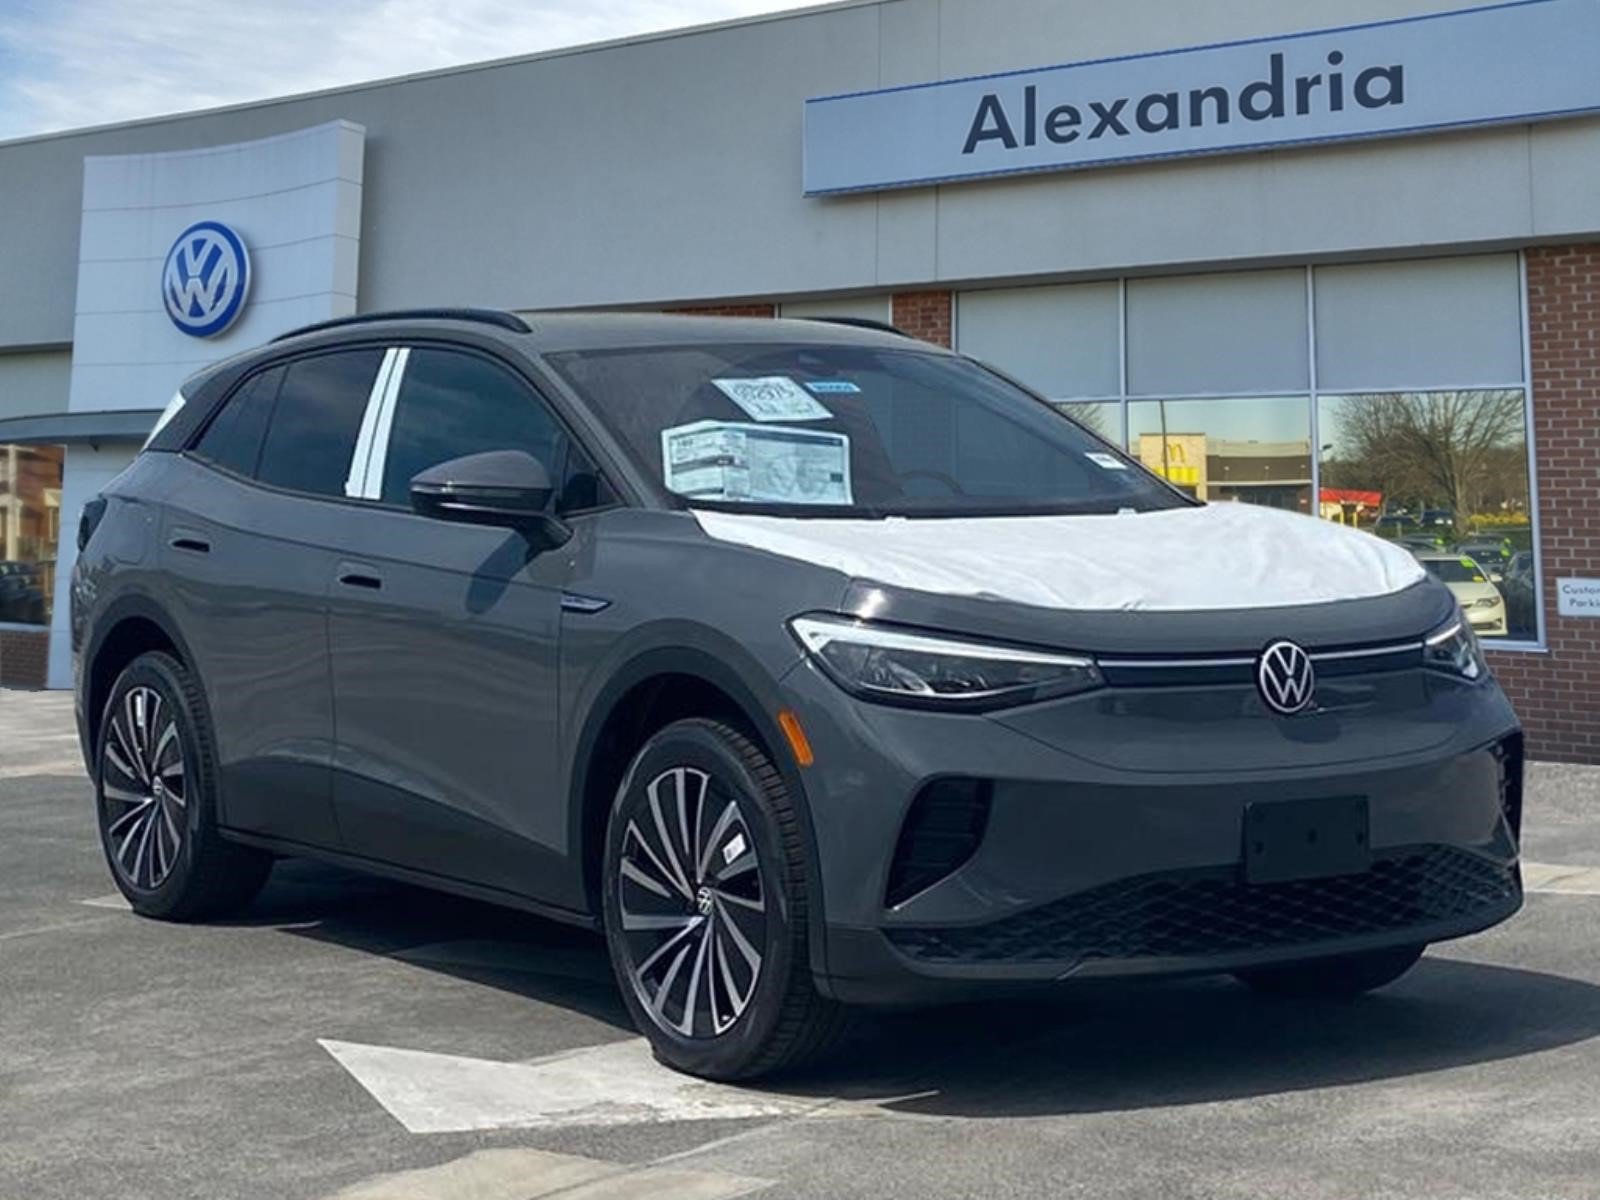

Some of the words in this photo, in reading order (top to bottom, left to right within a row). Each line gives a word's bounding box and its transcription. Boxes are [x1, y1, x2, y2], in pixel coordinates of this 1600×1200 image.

[962, 50, 1405, 154] Alexandria
[165, 226, 243, 331] VW
[1262, 643, 1312, 709] VW
